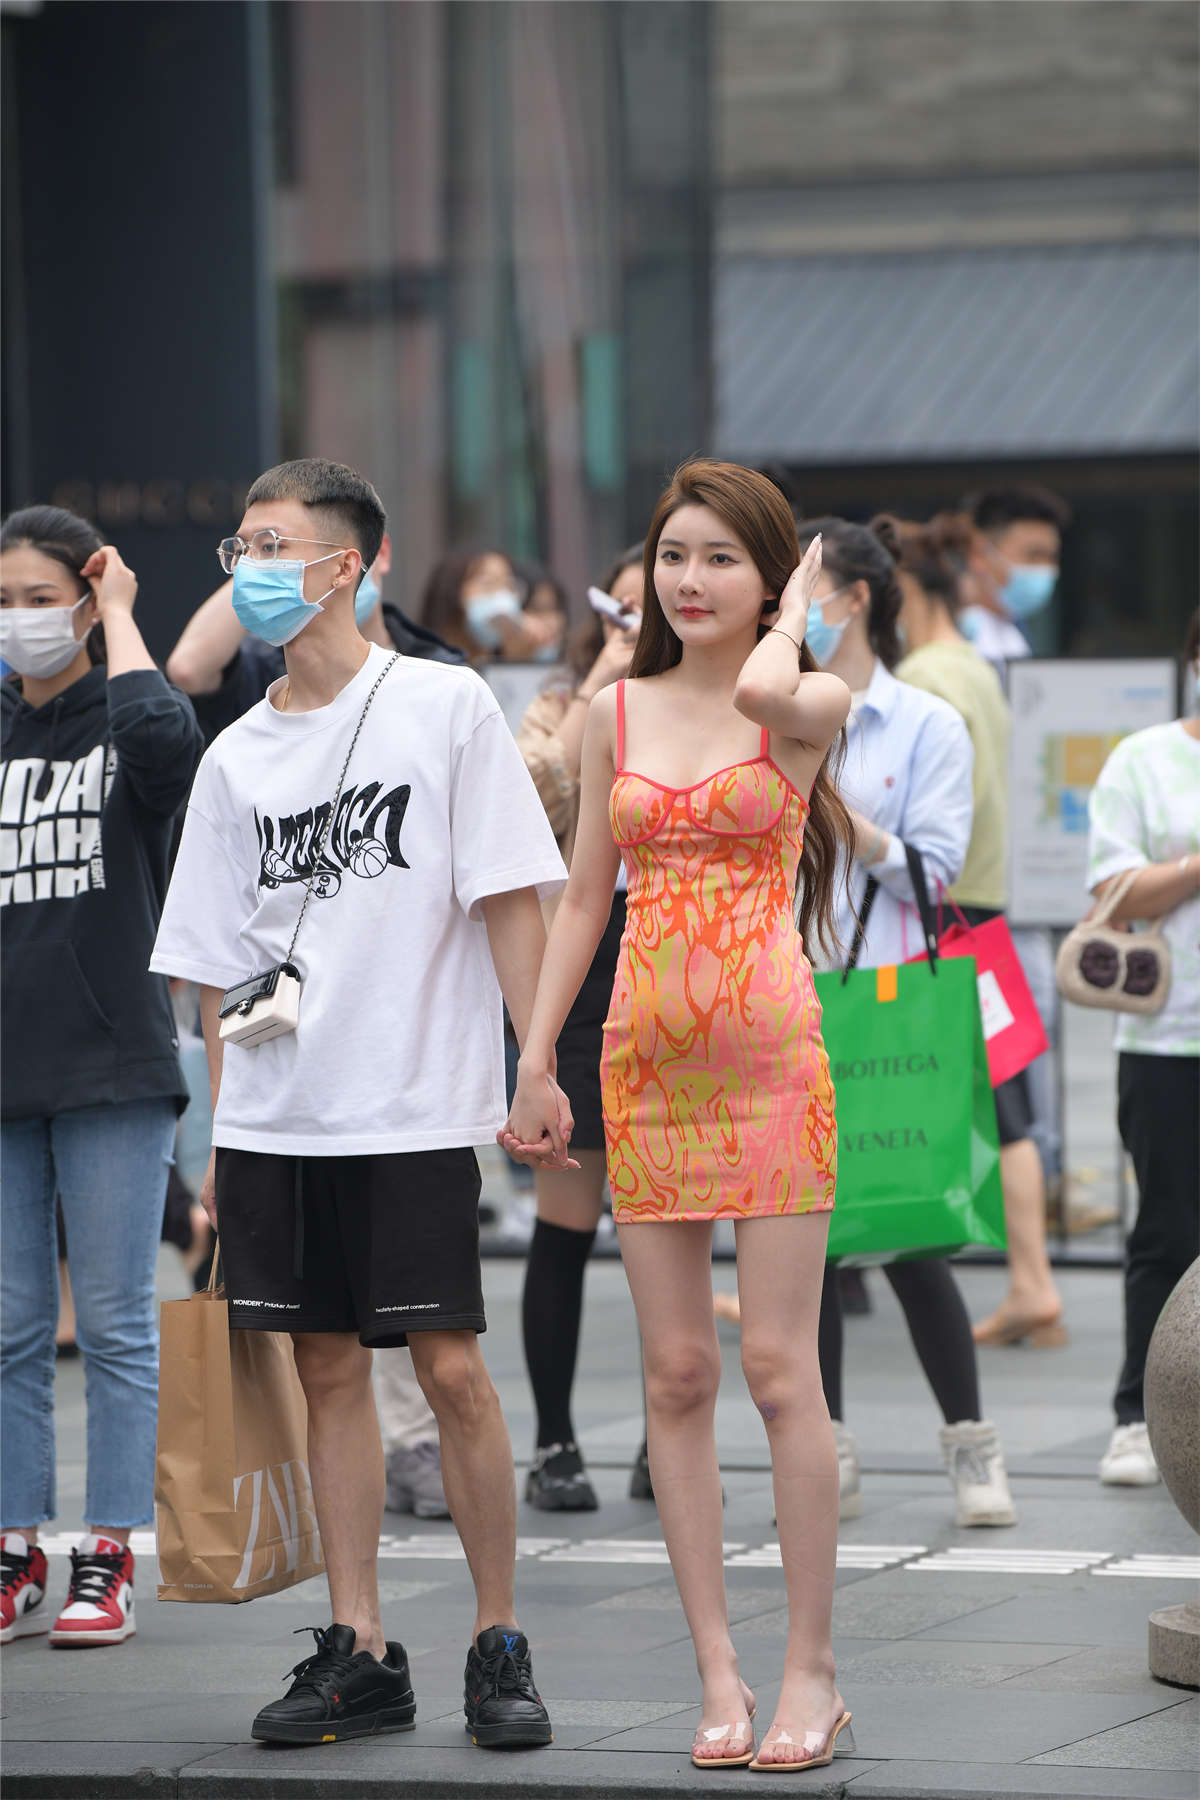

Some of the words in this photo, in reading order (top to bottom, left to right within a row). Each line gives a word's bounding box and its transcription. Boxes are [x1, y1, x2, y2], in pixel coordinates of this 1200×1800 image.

[834, 1053, 939, 1081] BOTTEGA
[843, 1128, 929, 1152] VENETA
[232, 1459, 325, 1589] ZAR
